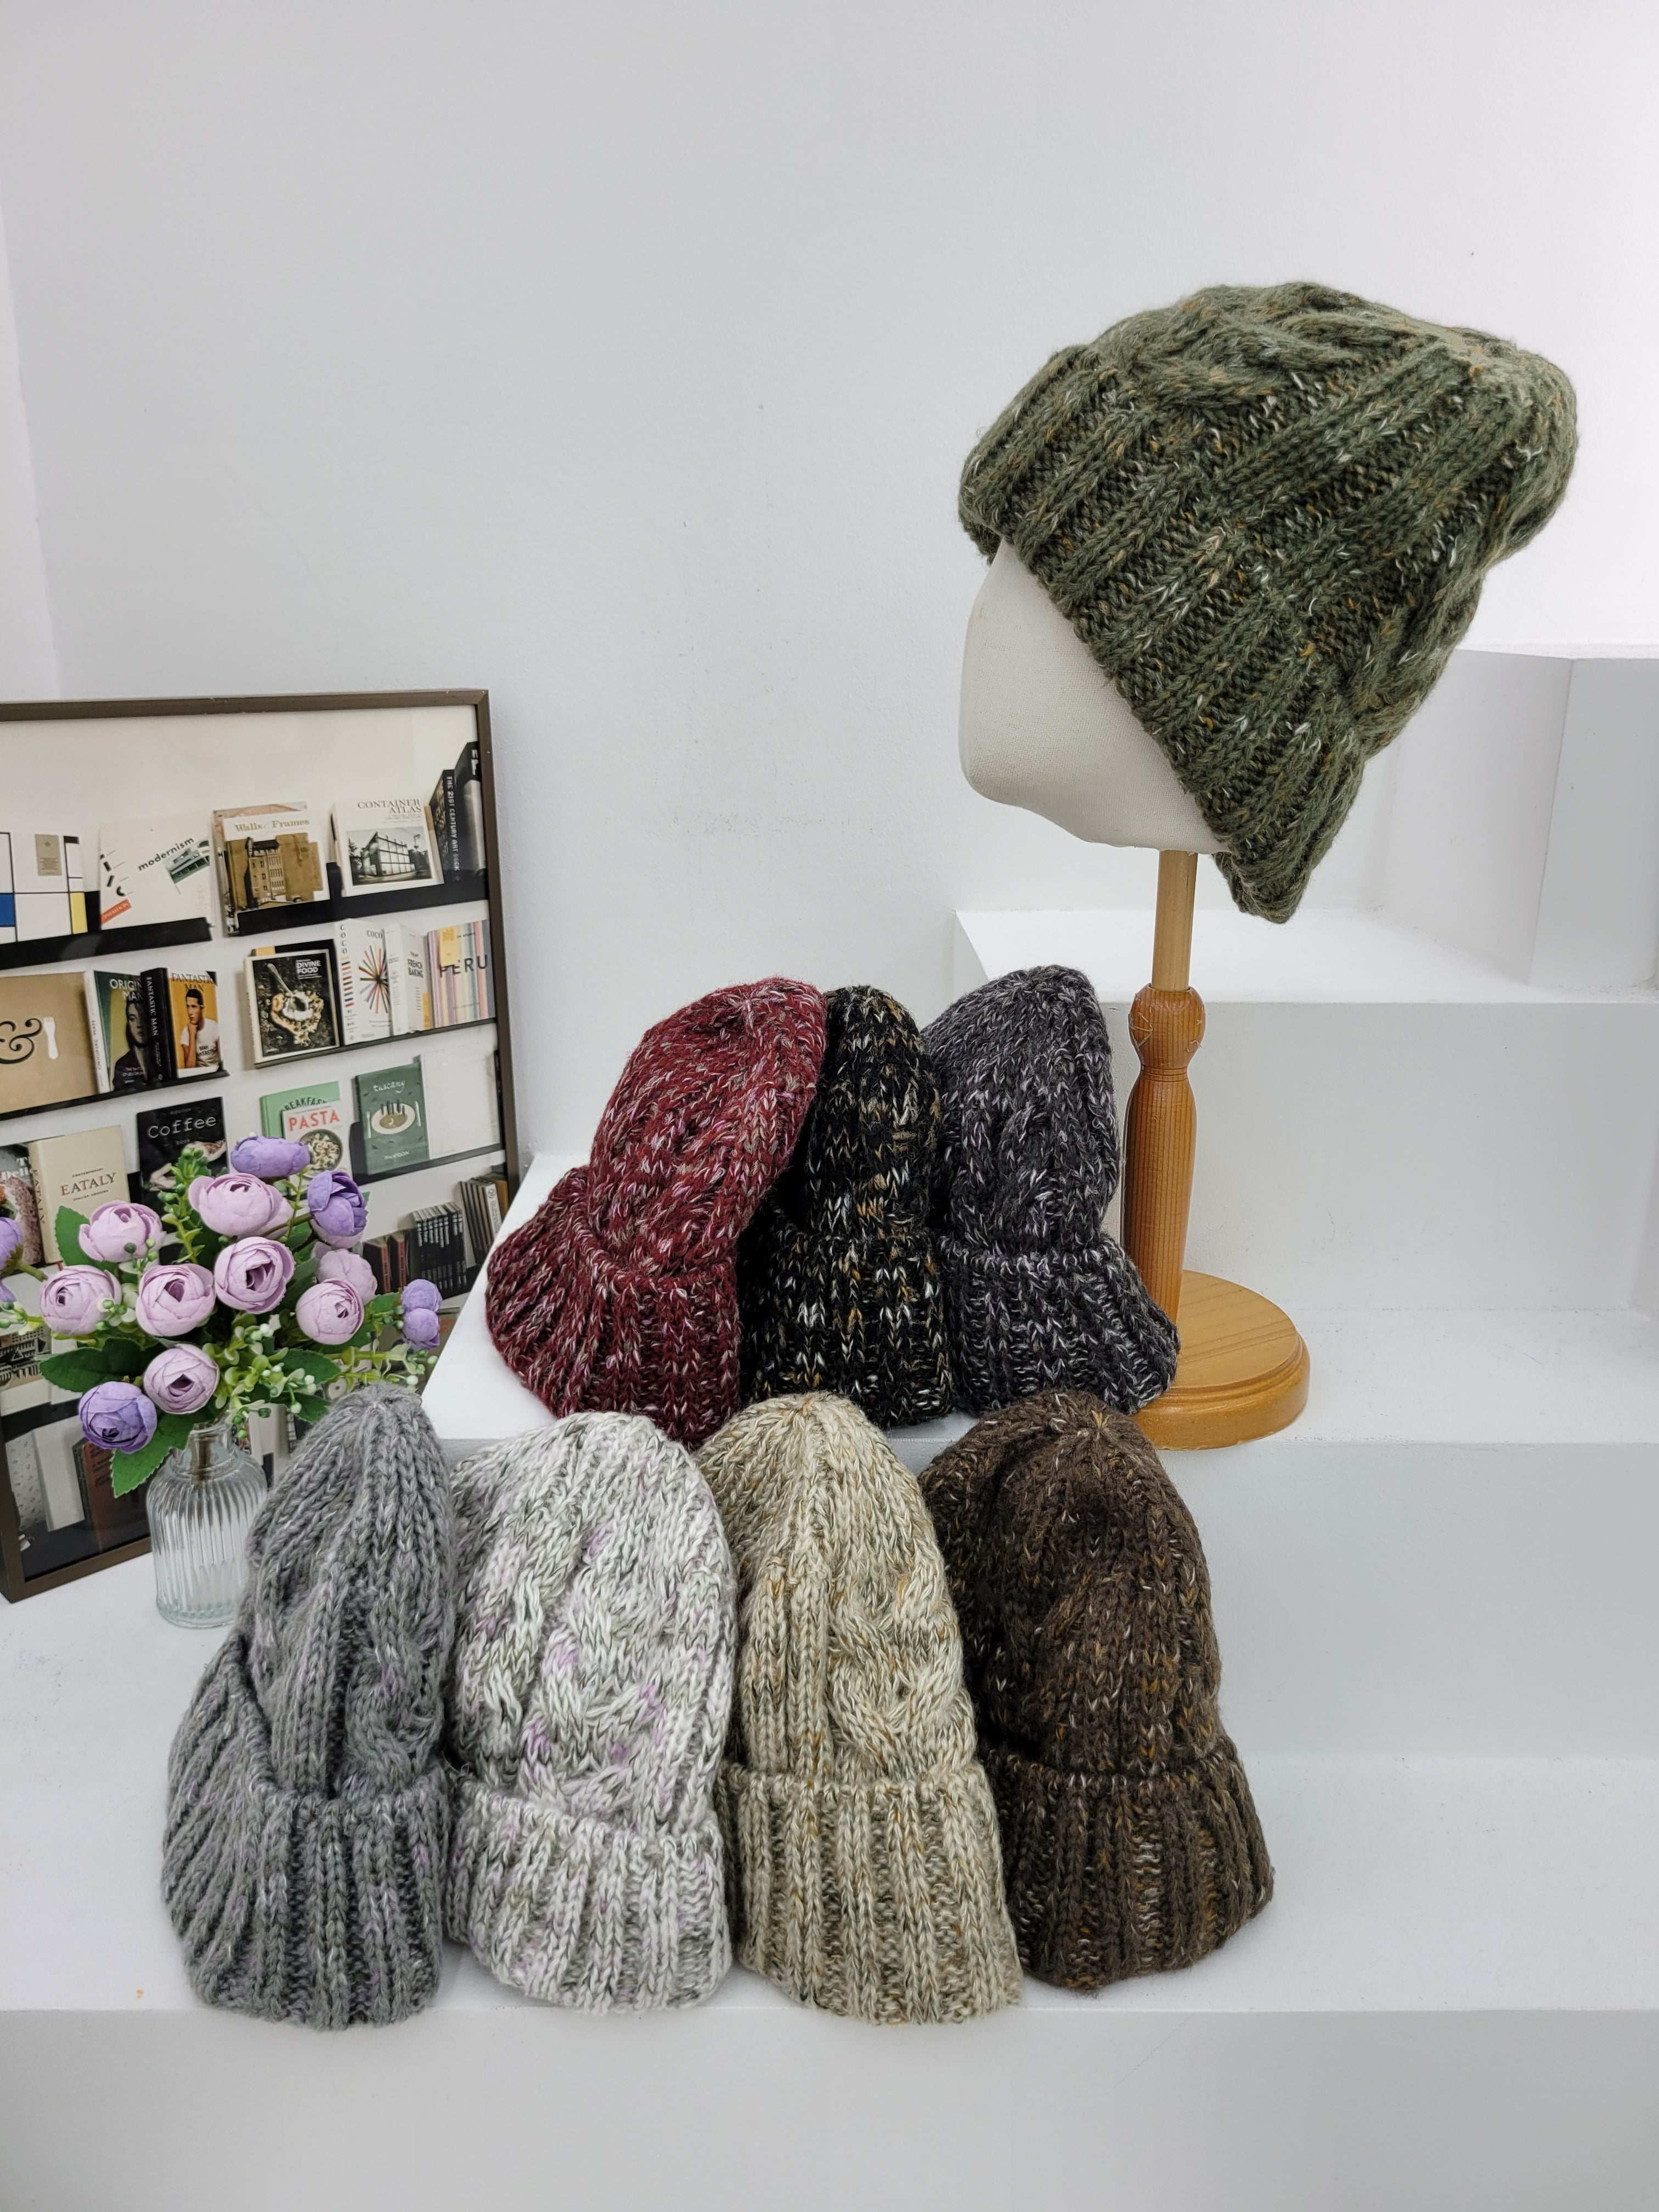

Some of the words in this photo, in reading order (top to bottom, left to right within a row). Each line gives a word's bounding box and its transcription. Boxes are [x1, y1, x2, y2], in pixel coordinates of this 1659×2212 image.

[357, 799, 421, 809] CONTAINER
[449, 808, 458, 838] CENTURY
[138, 837, 195, 871] modernism
[296, 960, 321, 968] DIVINE
[408, 959, 423, 969] FRENCH
[408, 969, 424, 978] BAKING
[146, 977, 156, 1016] FANTASTIC
[148, 1116, 217, 1138] Coffee
[289, 1110, 340, 1132] PASTA
[60, 1172, 117, 1197] EATALY
